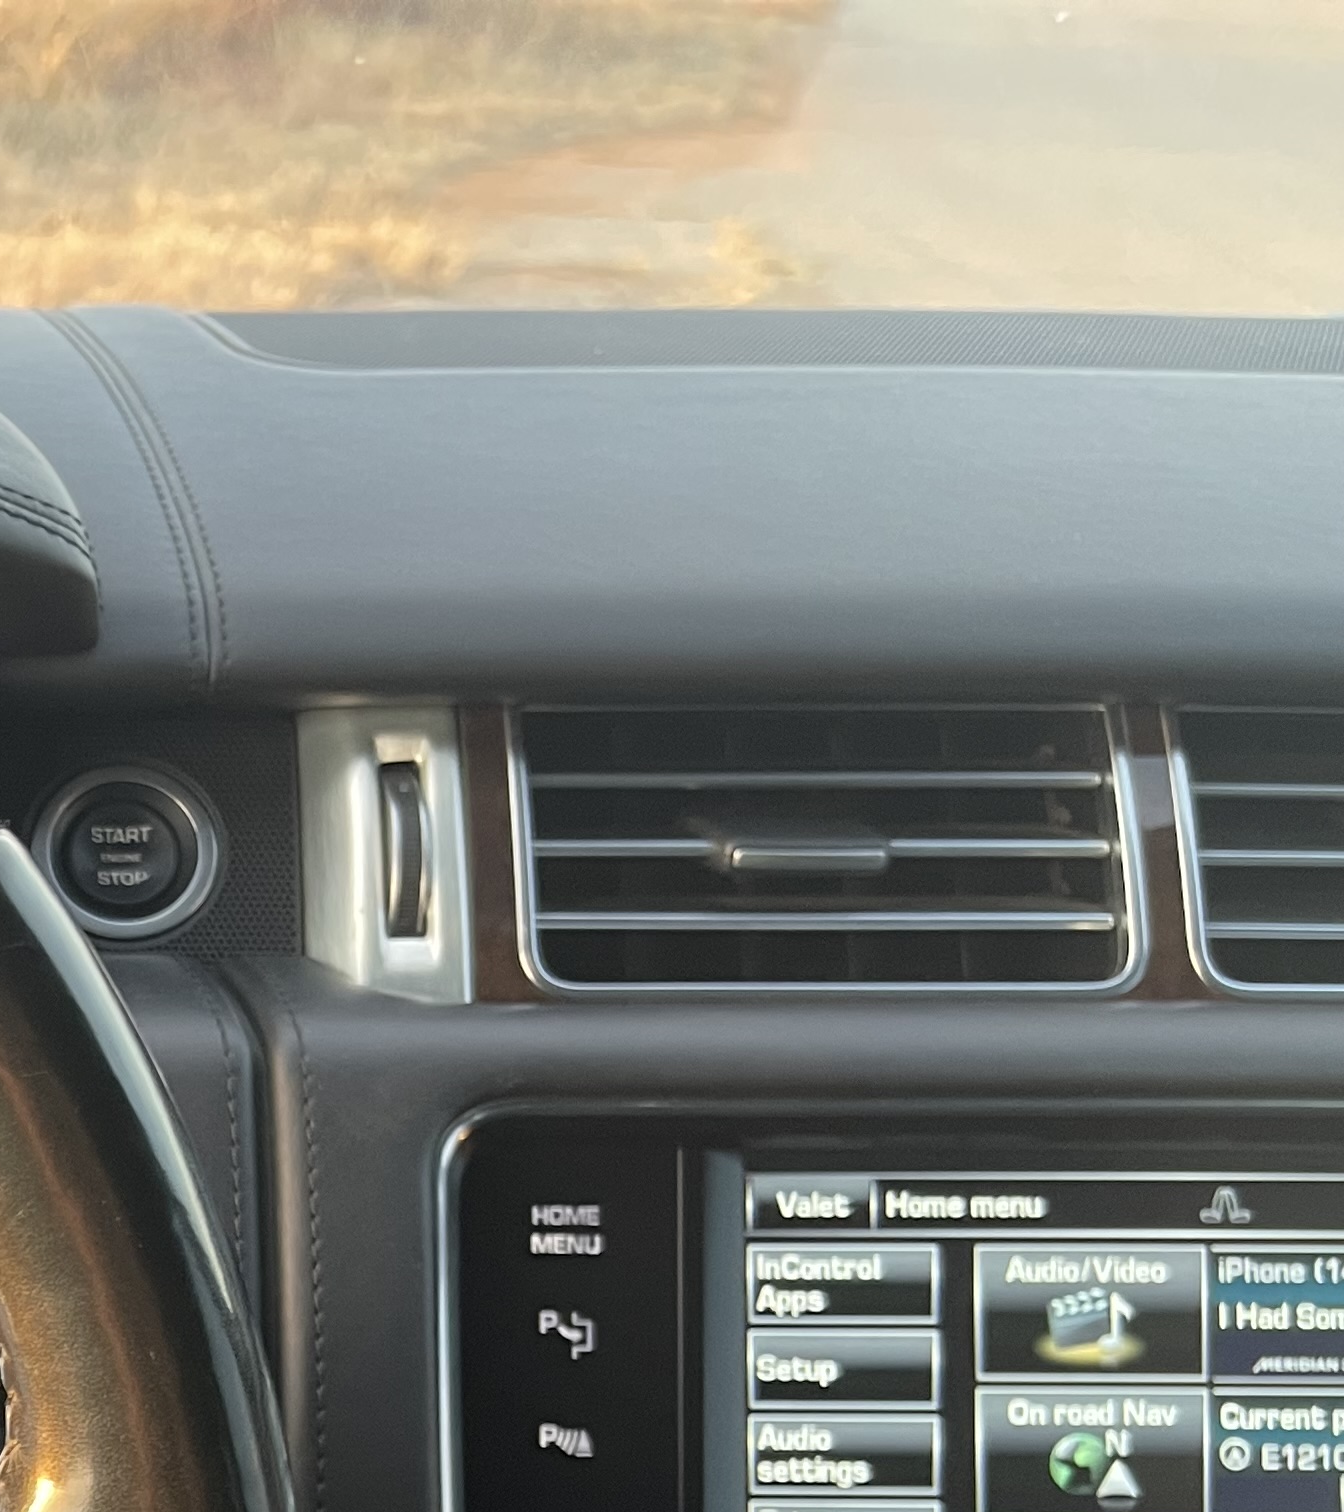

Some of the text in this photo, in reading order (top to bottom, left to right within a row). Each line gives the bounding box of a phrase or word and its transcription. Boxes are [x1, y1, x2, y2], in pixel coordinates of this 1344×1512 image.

[90, 826, 153, 844] START
[97, 871, 150, 886] STOP
[531, 1205, 601, 1227] HOME
[776, 1192, 853, 1218] Valet
[885, 1192, 1044, 1218] Home menu
[530, 1232, 603, 1256] MENU
[756, 1254, 883, 1281] InControl
[1006, 1256, 1169, 1285] Audio/Video
[1218, 1256, 1344, 1284] iPhone (1
[756, 1286, 829, 1316] Apps
[1236, 1301, 1290, 1330] Had
[756, 1355, 841, 1387] Setup
[1007, 1401, 1178, 1427] On road Nav
[1220, 1402, 1327, 1431] Current
[757, 1425, 832, 1451] Audio
[757, 1456, 873, 1489] settings
